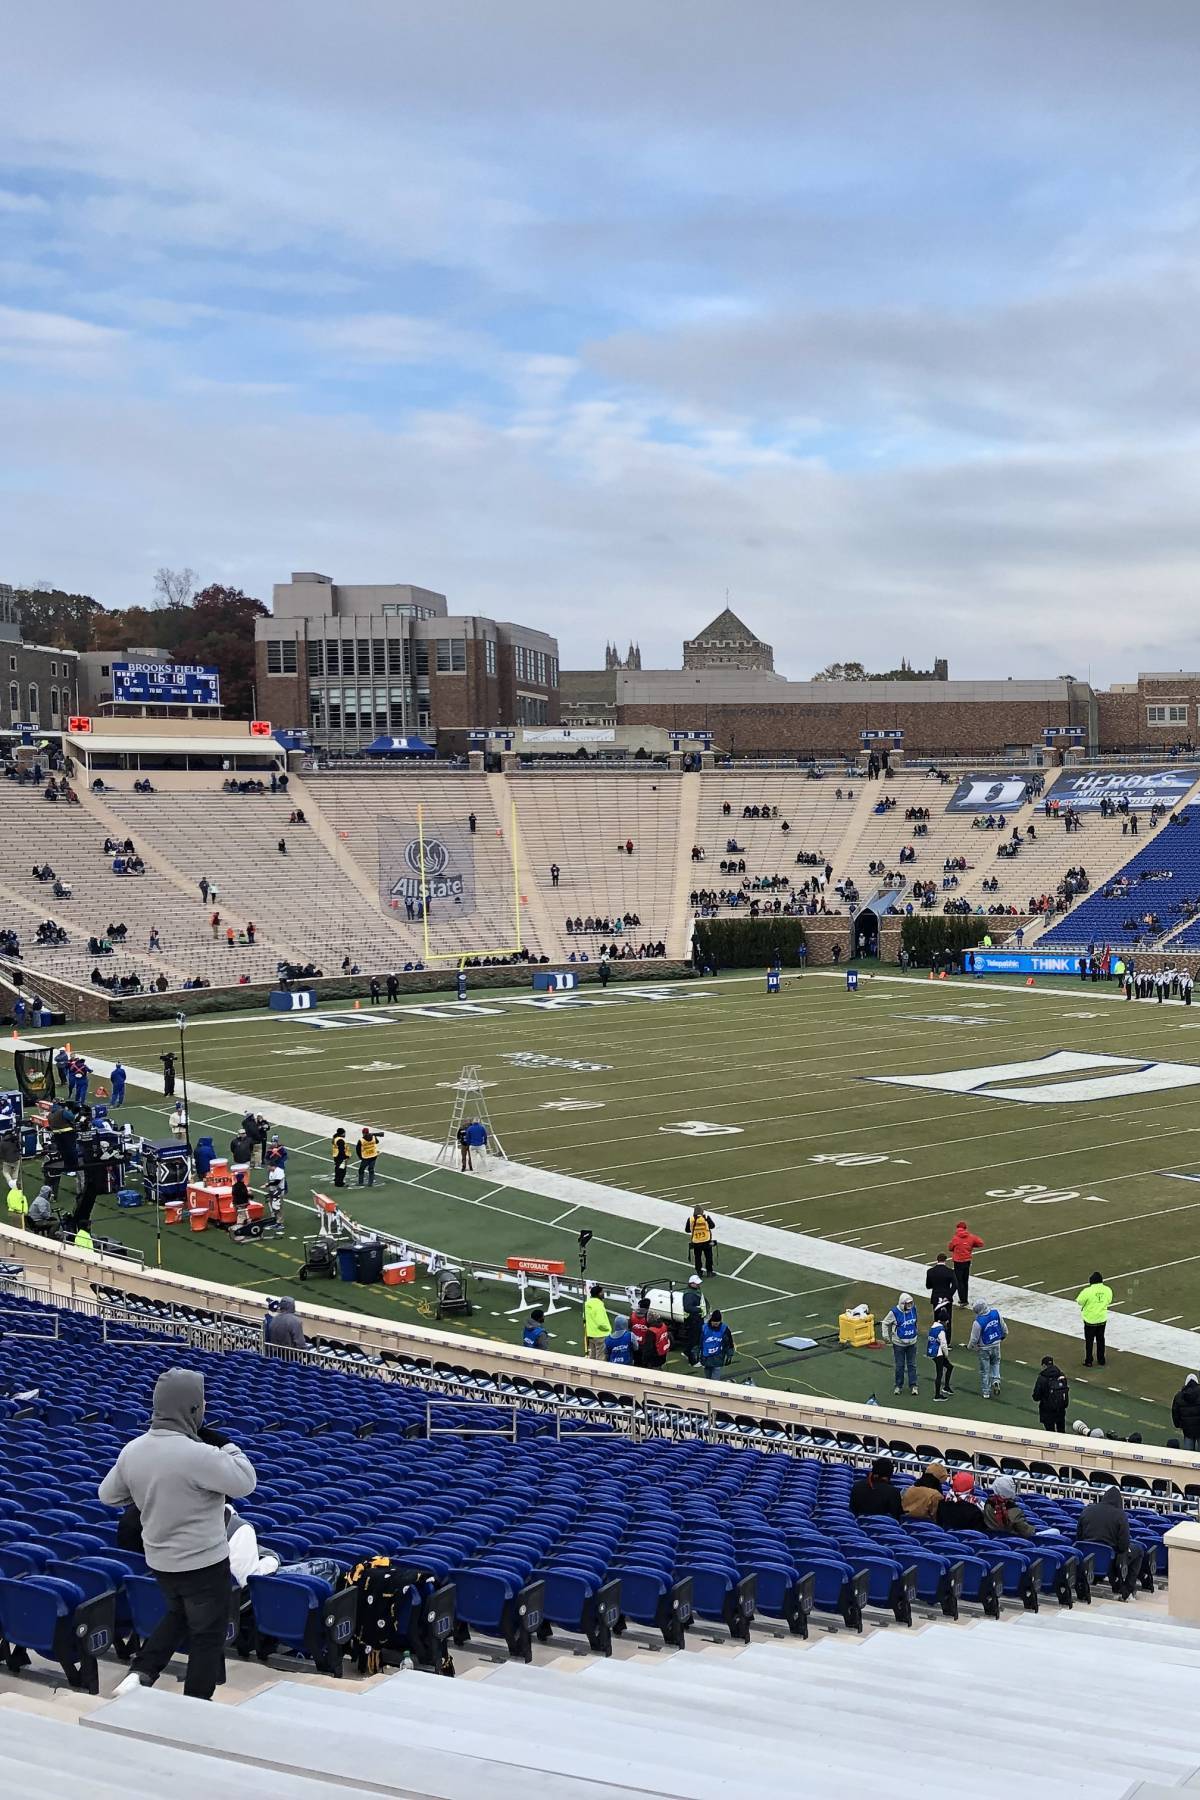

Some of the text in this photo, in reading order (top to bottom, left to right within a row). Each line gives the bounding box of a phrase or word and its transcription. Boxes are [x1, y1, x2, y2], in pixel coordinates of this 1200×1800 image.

[128, 663, 204, 674] BROOKS FIELD
[153, 673, 185, 684] 16:18
[1071, 774, 1176, 790] HEROES
[1074, 789, 1135, 798] Military
[392, 878, 462, 898] Allstate
[1030, 958, 1070, 970] THINK
[807, 1152, 890, 1166] 40
[190, 1192, 196, 1208] G
[985, 1184, 1081, 1204] 30
[400, 1268, 407, 1276] G
[518, 1261, 549, 1272] GATORADE
